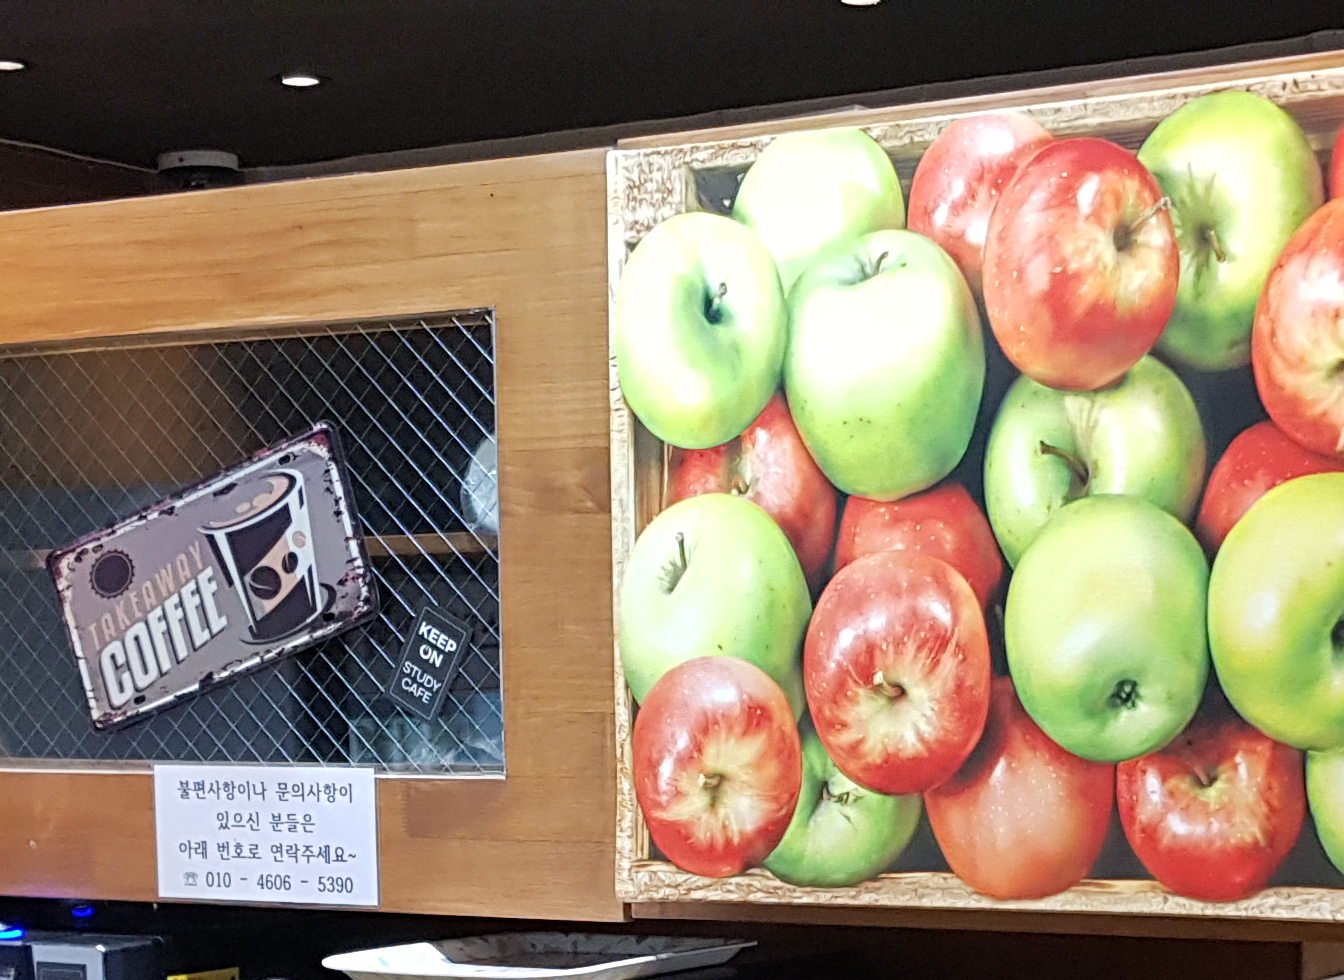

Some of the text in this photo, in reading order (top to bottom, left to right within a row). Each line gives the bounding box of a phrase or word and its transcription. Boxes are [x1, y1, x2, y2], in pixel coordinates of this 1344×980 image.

[88, 541, 204, 649] TAKEAWAY
[99, 566, 228, 708] COFFEE
[418, 621, 457, 652] KEEP
[419, 644, 444, 667] ON
[402, 661, 442, 692] STUDY
[401, 678, 433, 704] CAFE
[177, 780, 354, 803] 불편사항이나 문의사항이
[216, 811, 316, 833] 있으신 분들은
[178, 839, 357, 864] 아래 번호로 연락주세요~
[206, 871, 232, 888] 010
[257, 873, 292, 890] 4606
[317, 876, 354, 894] 5390
